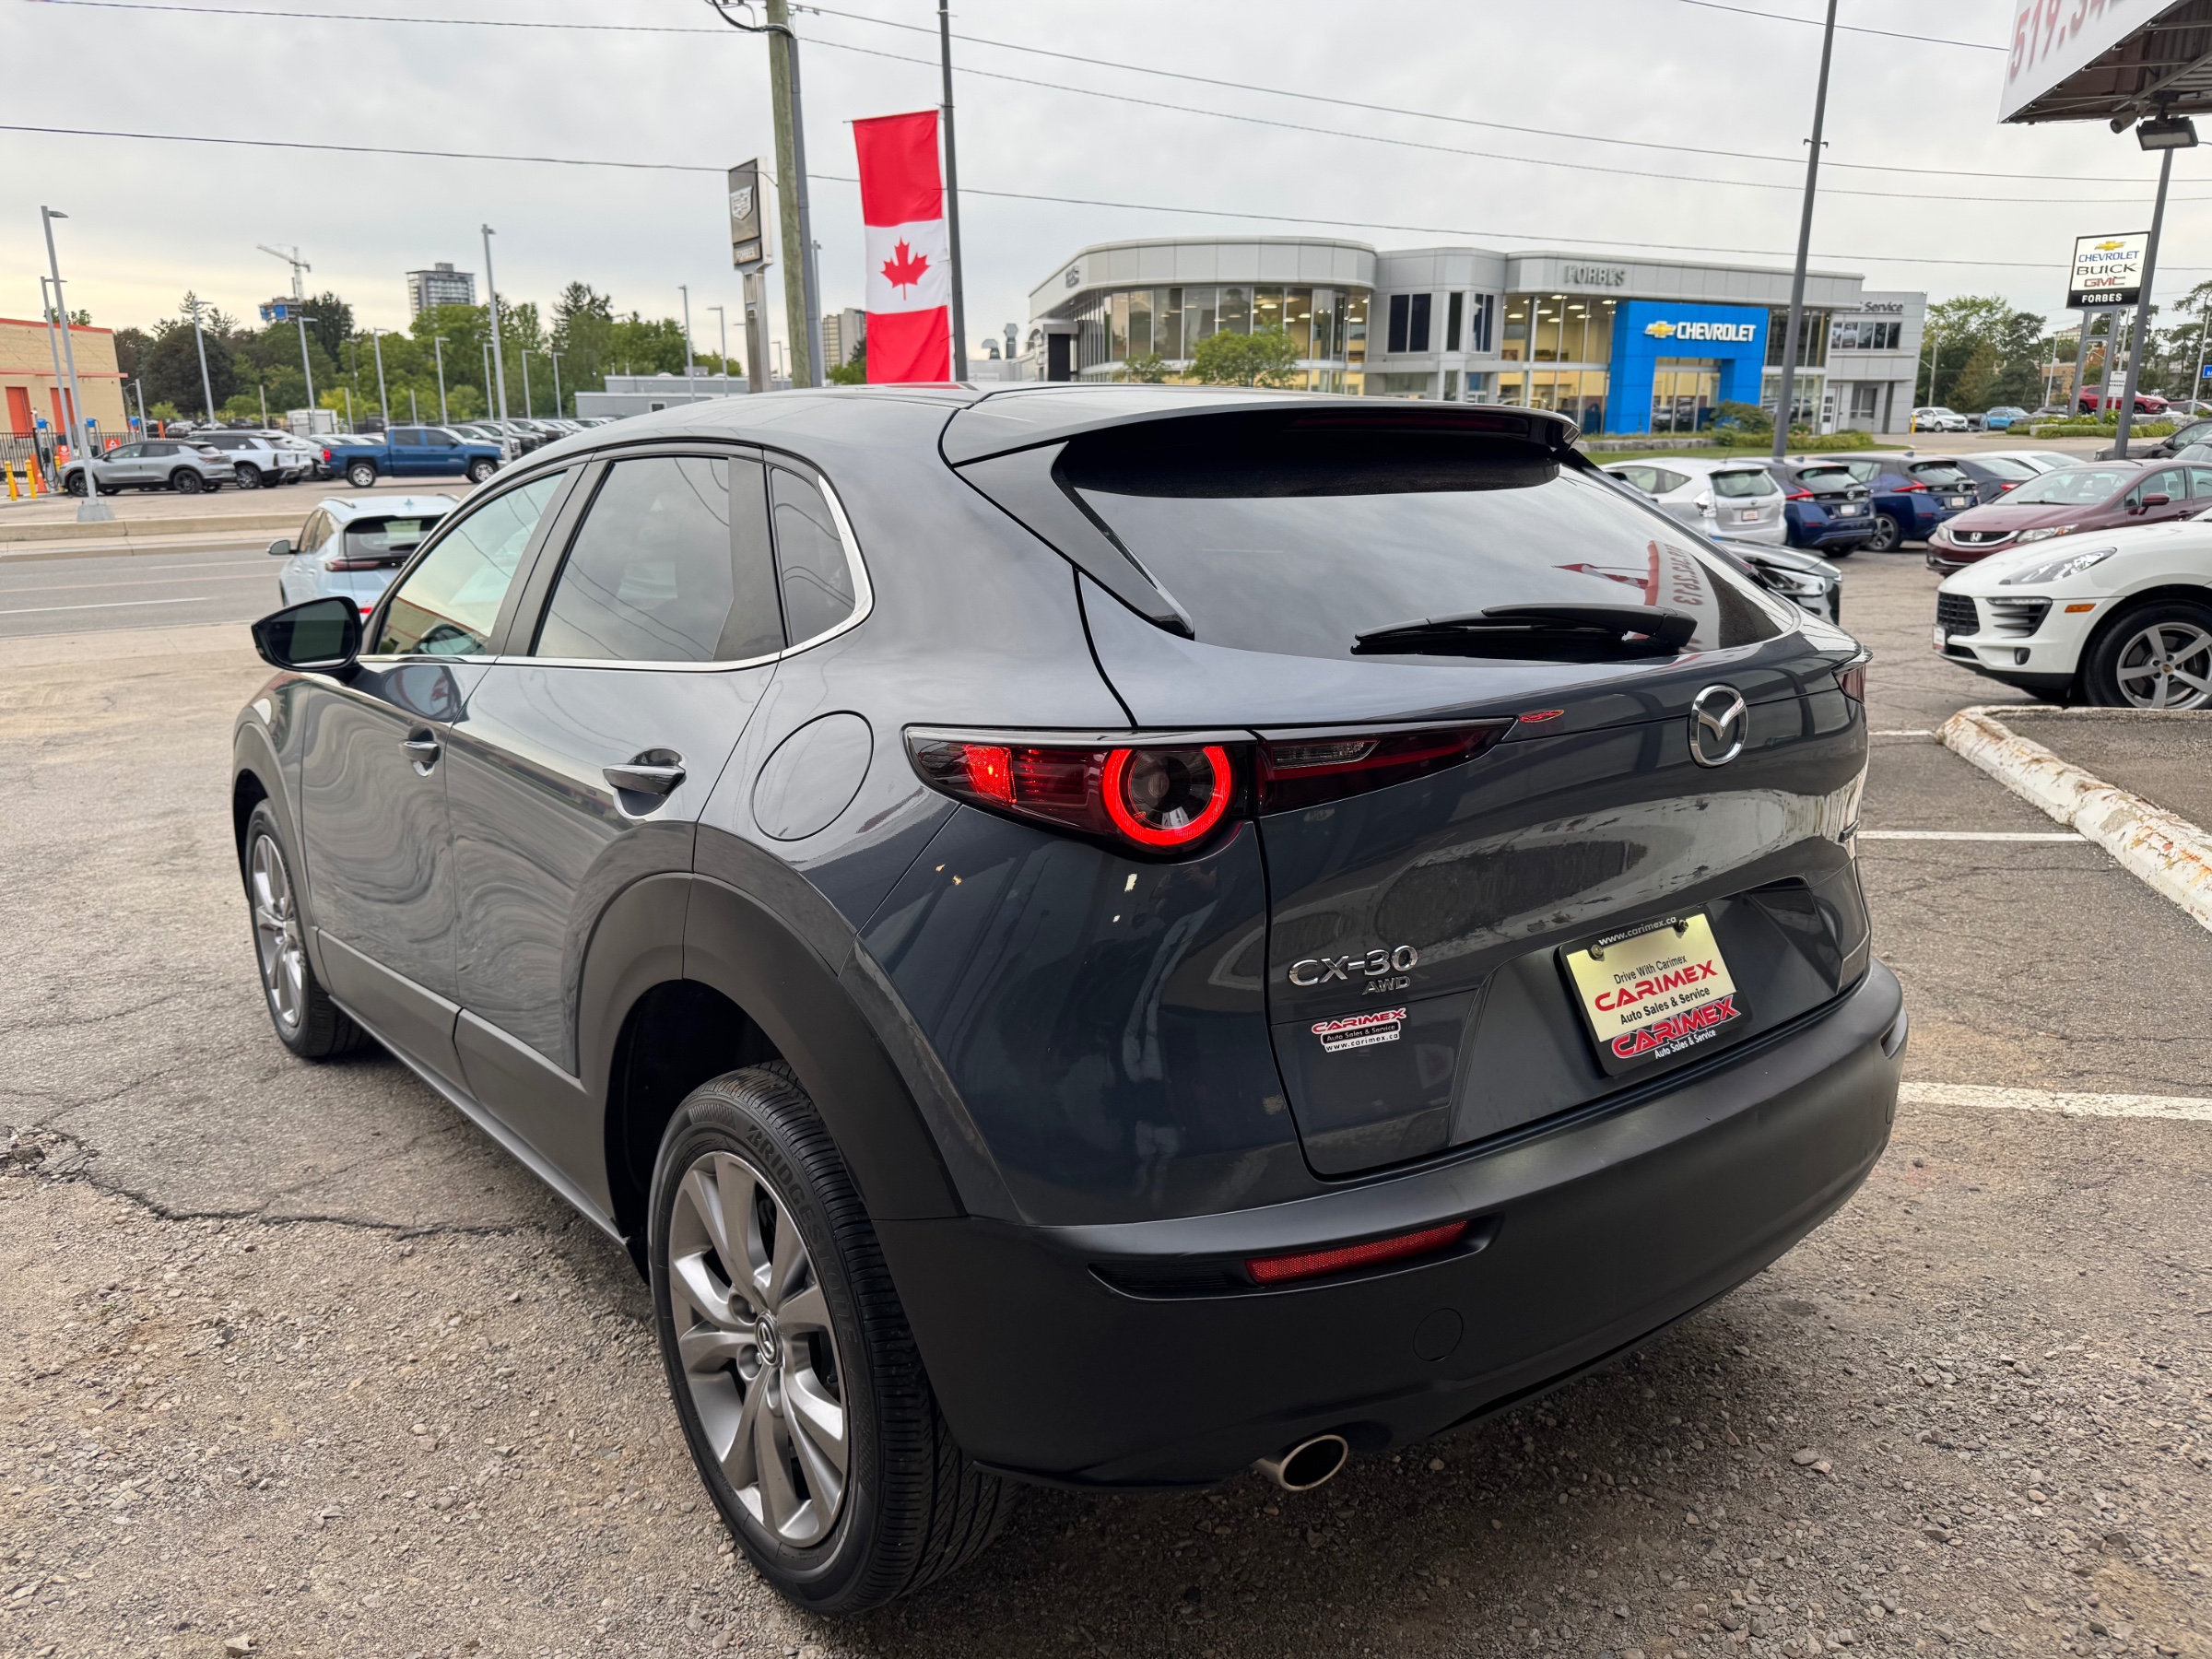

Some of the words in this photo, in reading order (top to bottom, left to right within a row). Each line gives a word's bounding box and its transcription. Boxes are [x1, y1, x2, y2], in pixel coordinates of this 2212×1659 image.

[2078, 250, 2139, 263] CHEVROLET
[1564, 265, 1626, 287] FORBES
[2077, 263, 2137, 276] BUICK
[2084, 276, 2126, 288] GMC
[1865, 301, 1903, 312] Service
[2081, 293, 2123, 303] FORBES
[1677, 322, 1757, 342] CHEVROLET
[1598, 916, 1677, 946] www.carimex.ca
[1288, 945, 1418, 986] CX-30
[1614, 971, 1637, 984] Drive
[1636, 963, 1656, 976] With
[1655, 955, 1688, 971] Carimex
[1361, 975, 1411, 995] AWD
[1594, 959, 1718, 1012] CARIMEX
[1619, 1009, 1642, 1025] Auto
[1643, 999, 1670, 1017] Sales
[1670, 996, 1678, 1006] &
[1678, 986, 1711, 1004] Service
[1312, 1008, 1406, 1032] CARIMEX
[1612, 995, 1740, 1058] CARIMEX
[1326, 1033, 1343, 1042] Auto
[1345, 1030, 1363, 1039] Sales
[1371, 1024, 1395, 1033] Service
[1326, 1033, 1398, 1052] www.carimex.ca
[1654, 1047, 1671, 1060] Auto
[1669, 1041, 1688, 1053] Sales
[1688, 1037, 1695, 1045] &
[1693, 1029, 1716, 1043] Service
